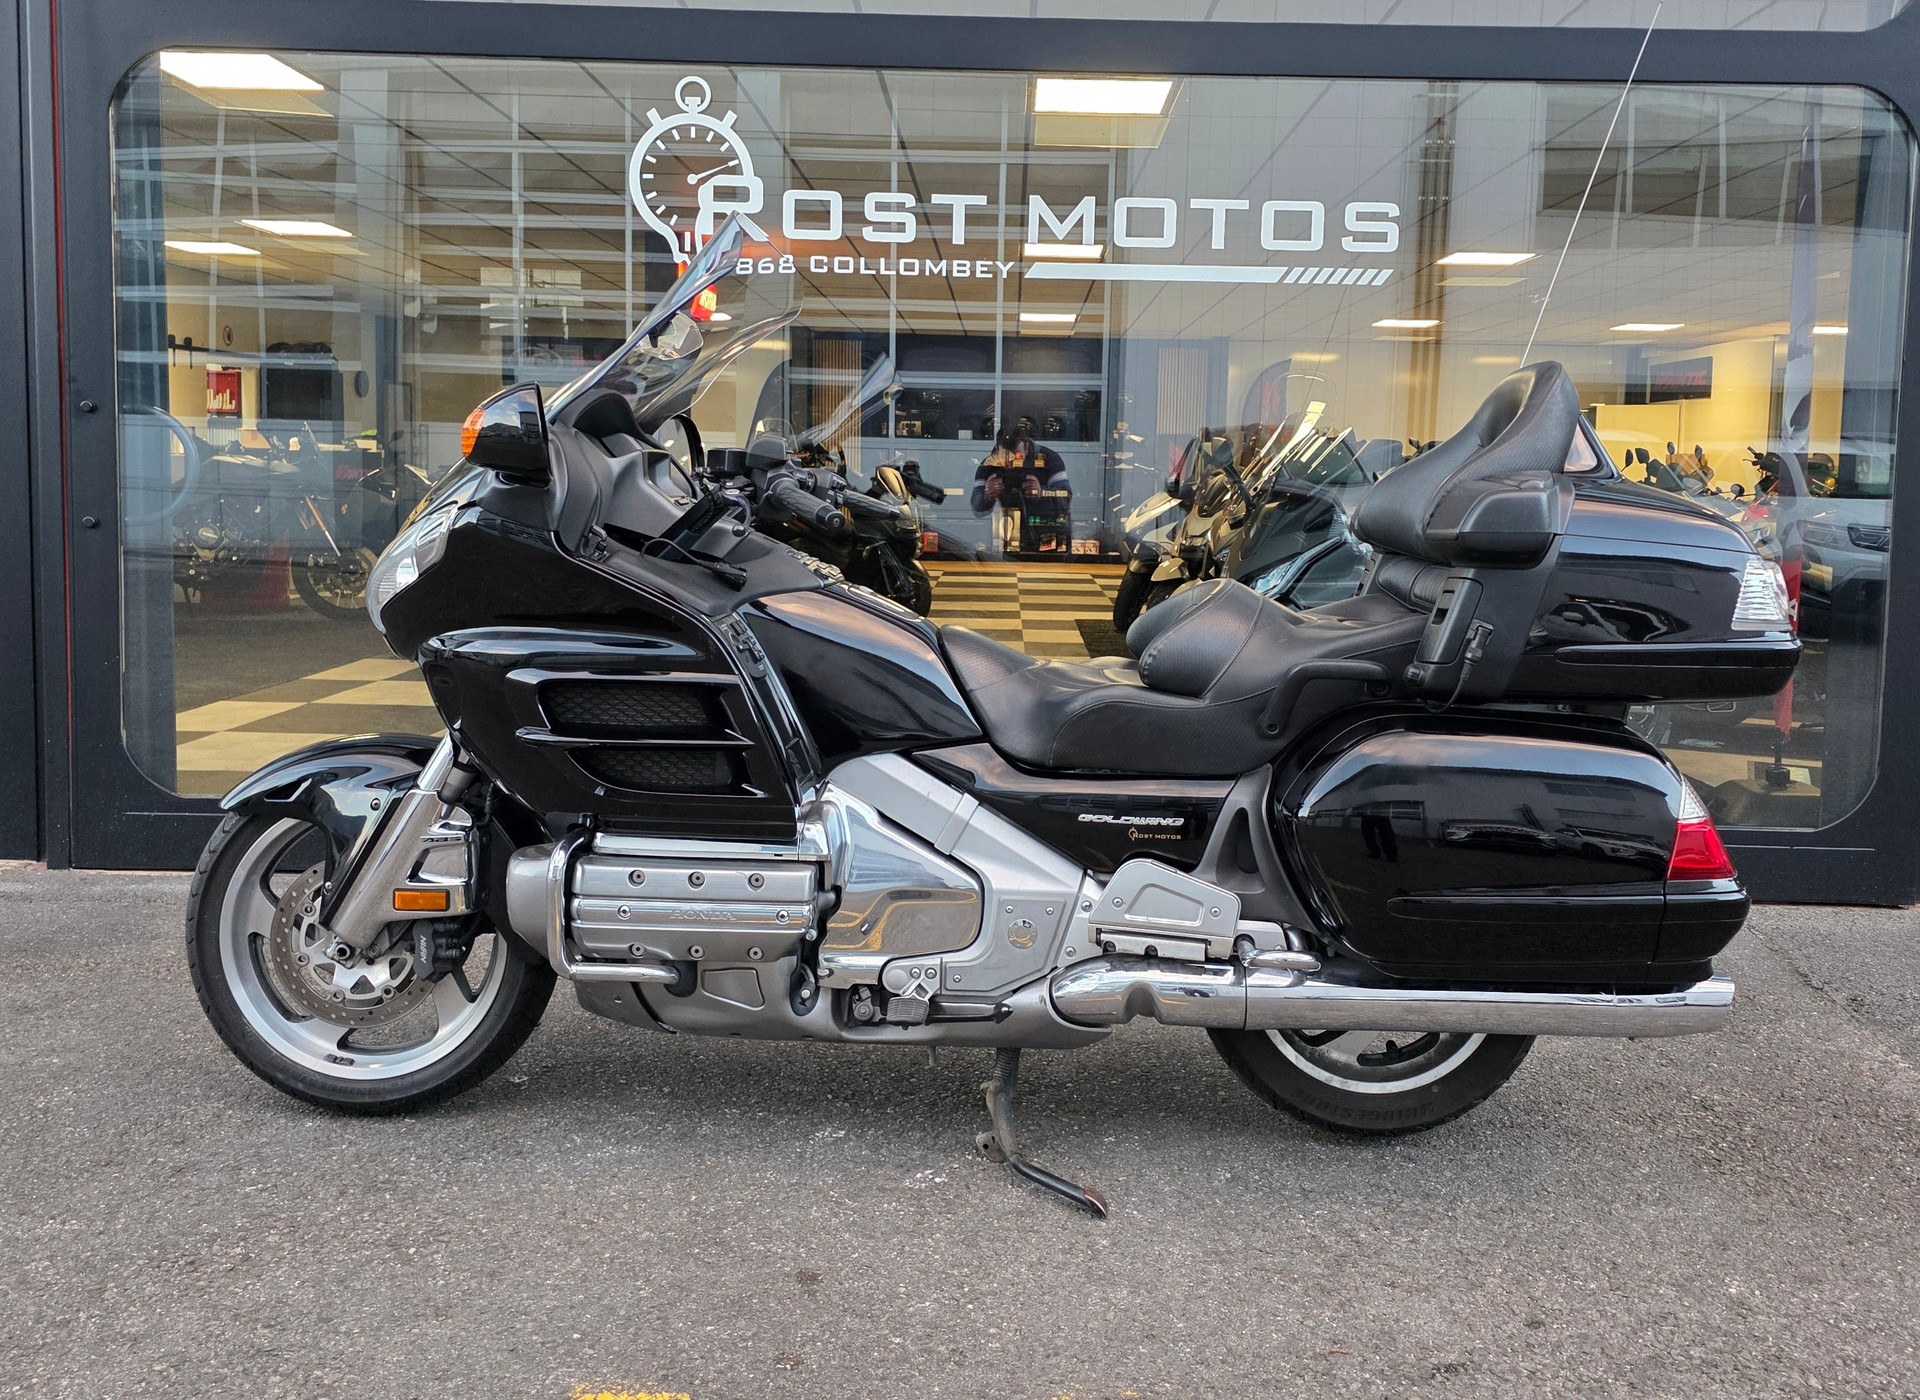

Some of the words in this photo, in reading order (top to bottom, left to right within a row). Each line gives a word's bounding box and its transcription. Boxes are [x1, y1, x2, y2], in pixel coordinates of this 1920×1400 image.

[695, 174, 988, 245] ROST
[1028, 194, 1401, 253] MOTOS
[809, 255, 1016, 279] COLLOMBEY
[669, 909, 737, 921] HONDA
